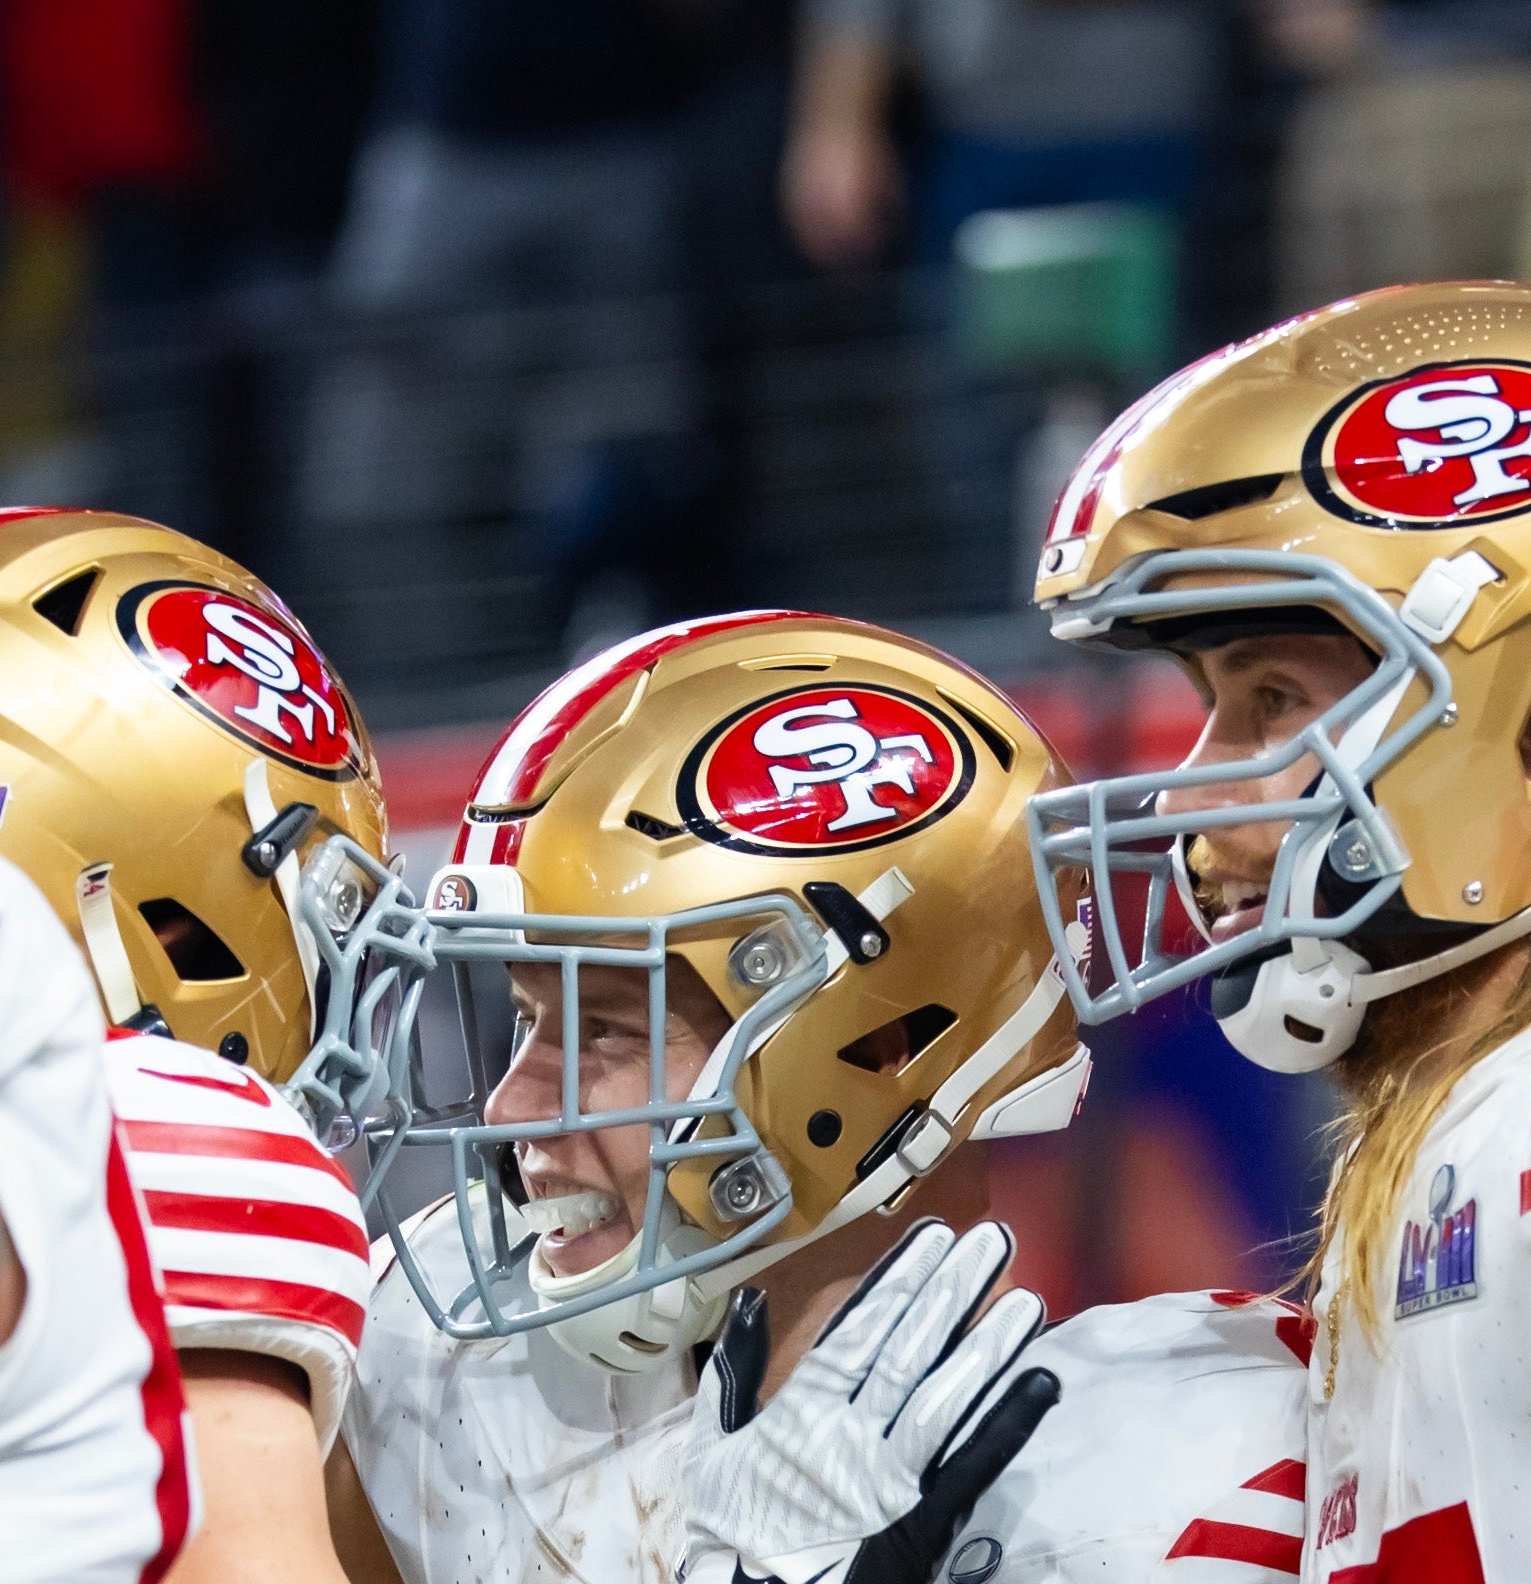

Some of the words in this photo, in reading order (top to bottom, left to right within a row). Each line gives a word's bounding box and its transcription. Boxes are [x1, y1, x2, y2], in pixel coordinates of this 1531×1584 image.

[202, 602, 335, 744] SF
[753, 698, 935, 832] SF
[1397, 1197, 1477, 1305] LVIII
[1399, 1293, 1432, 1318] SUPER
[1436, 1287, 1469, 1304] BOWL
